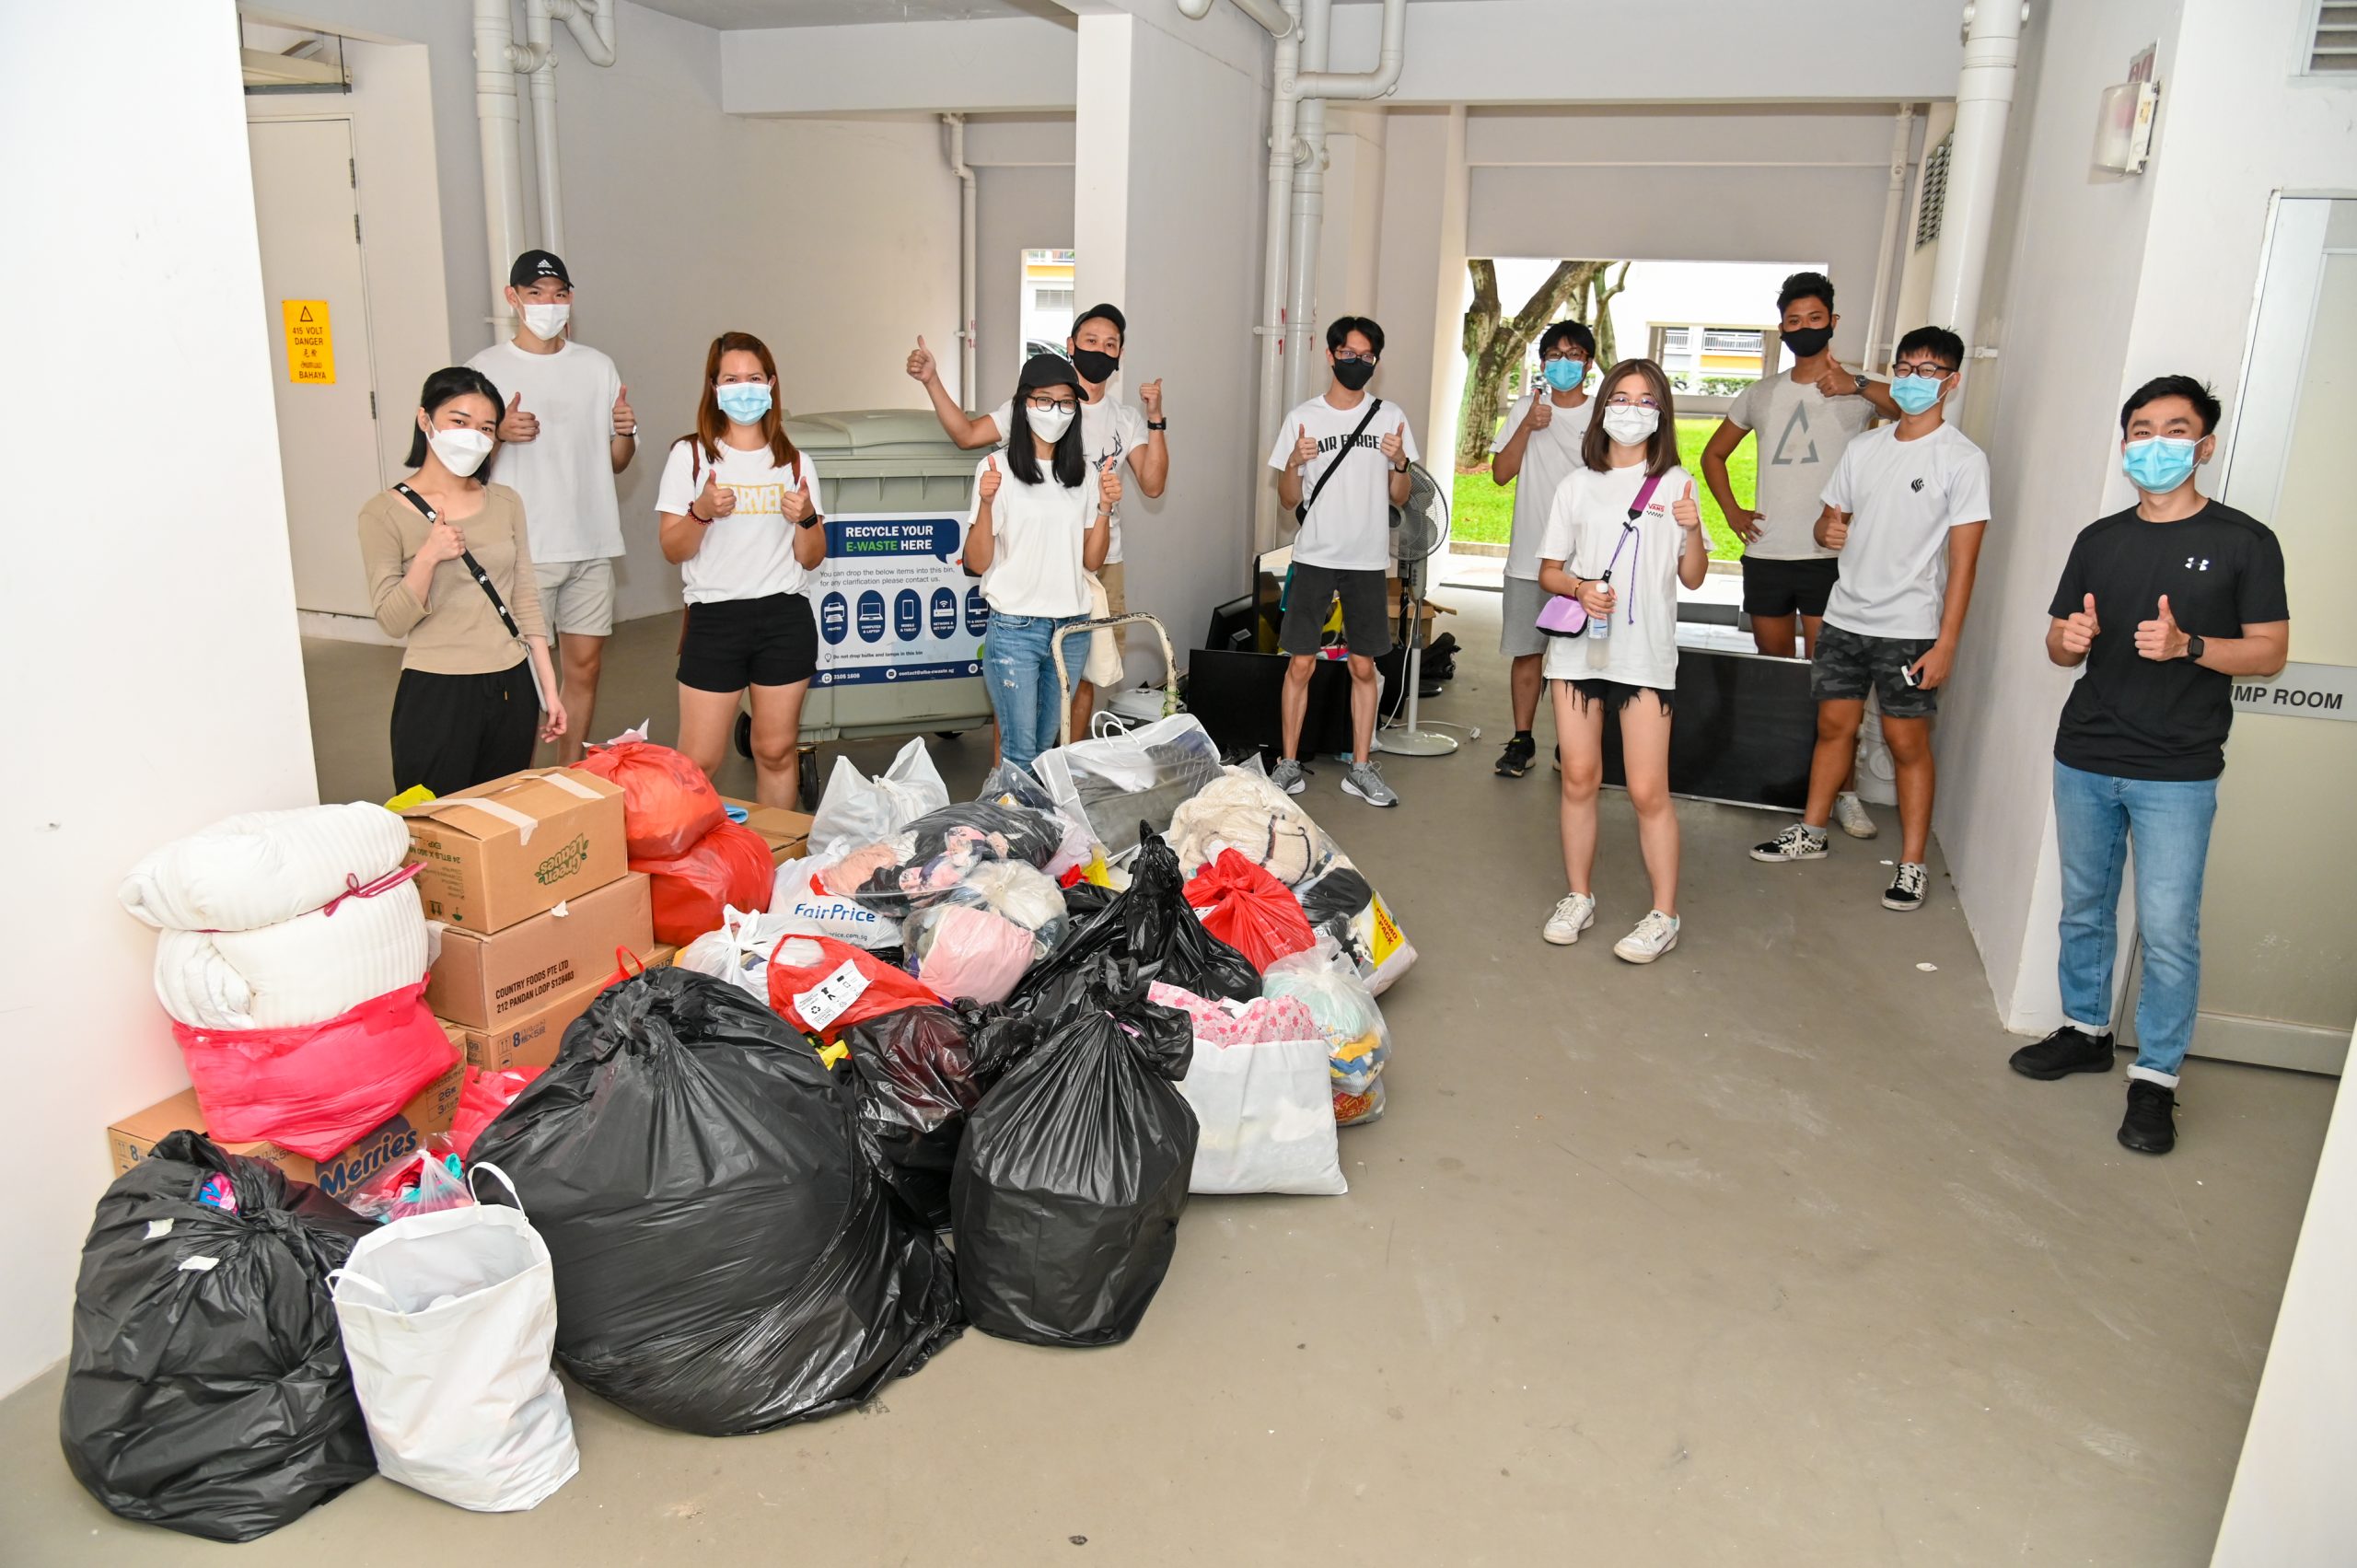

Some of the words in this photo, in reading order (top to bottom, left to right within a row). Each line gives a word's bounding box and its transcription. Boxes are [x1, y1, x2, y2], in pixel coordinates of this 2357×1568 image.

[1317, 435, 1338, 456] AIR
[1648, 503, 1665, 513] VANS
[846, 527, 899, 537] RECYCLE
[901, 526, 933, 535] YOUR
[846, 540, 898, 552] E-WASTE
[900, 539, 933, 551] HERE
[846, 569, 862, 577] drop
[929, 565, 942, 574] this
[881, 577, 904, 586] please
[2272, 688, 2343, 710] ROOM
[540, 832, 584, 875] Leaves
[544, 853, 582, 885] Green
[794, 902, 876, 923] FairPrice
[1378, 920, 1394, 945] PACK
[495, 981, 525, 999] COUNTRY
[526, 970, 546, 987] FOODS
[547, 964, 558, 977] PTE
[558, 959, 569, 972] LTD
[496, 1001, 508, 1014] 212
[509, 989, 534, 1008] PANDAN
[535, 981, 551, 997] LOOP
[319, 1129, 419, 1197] Merries
